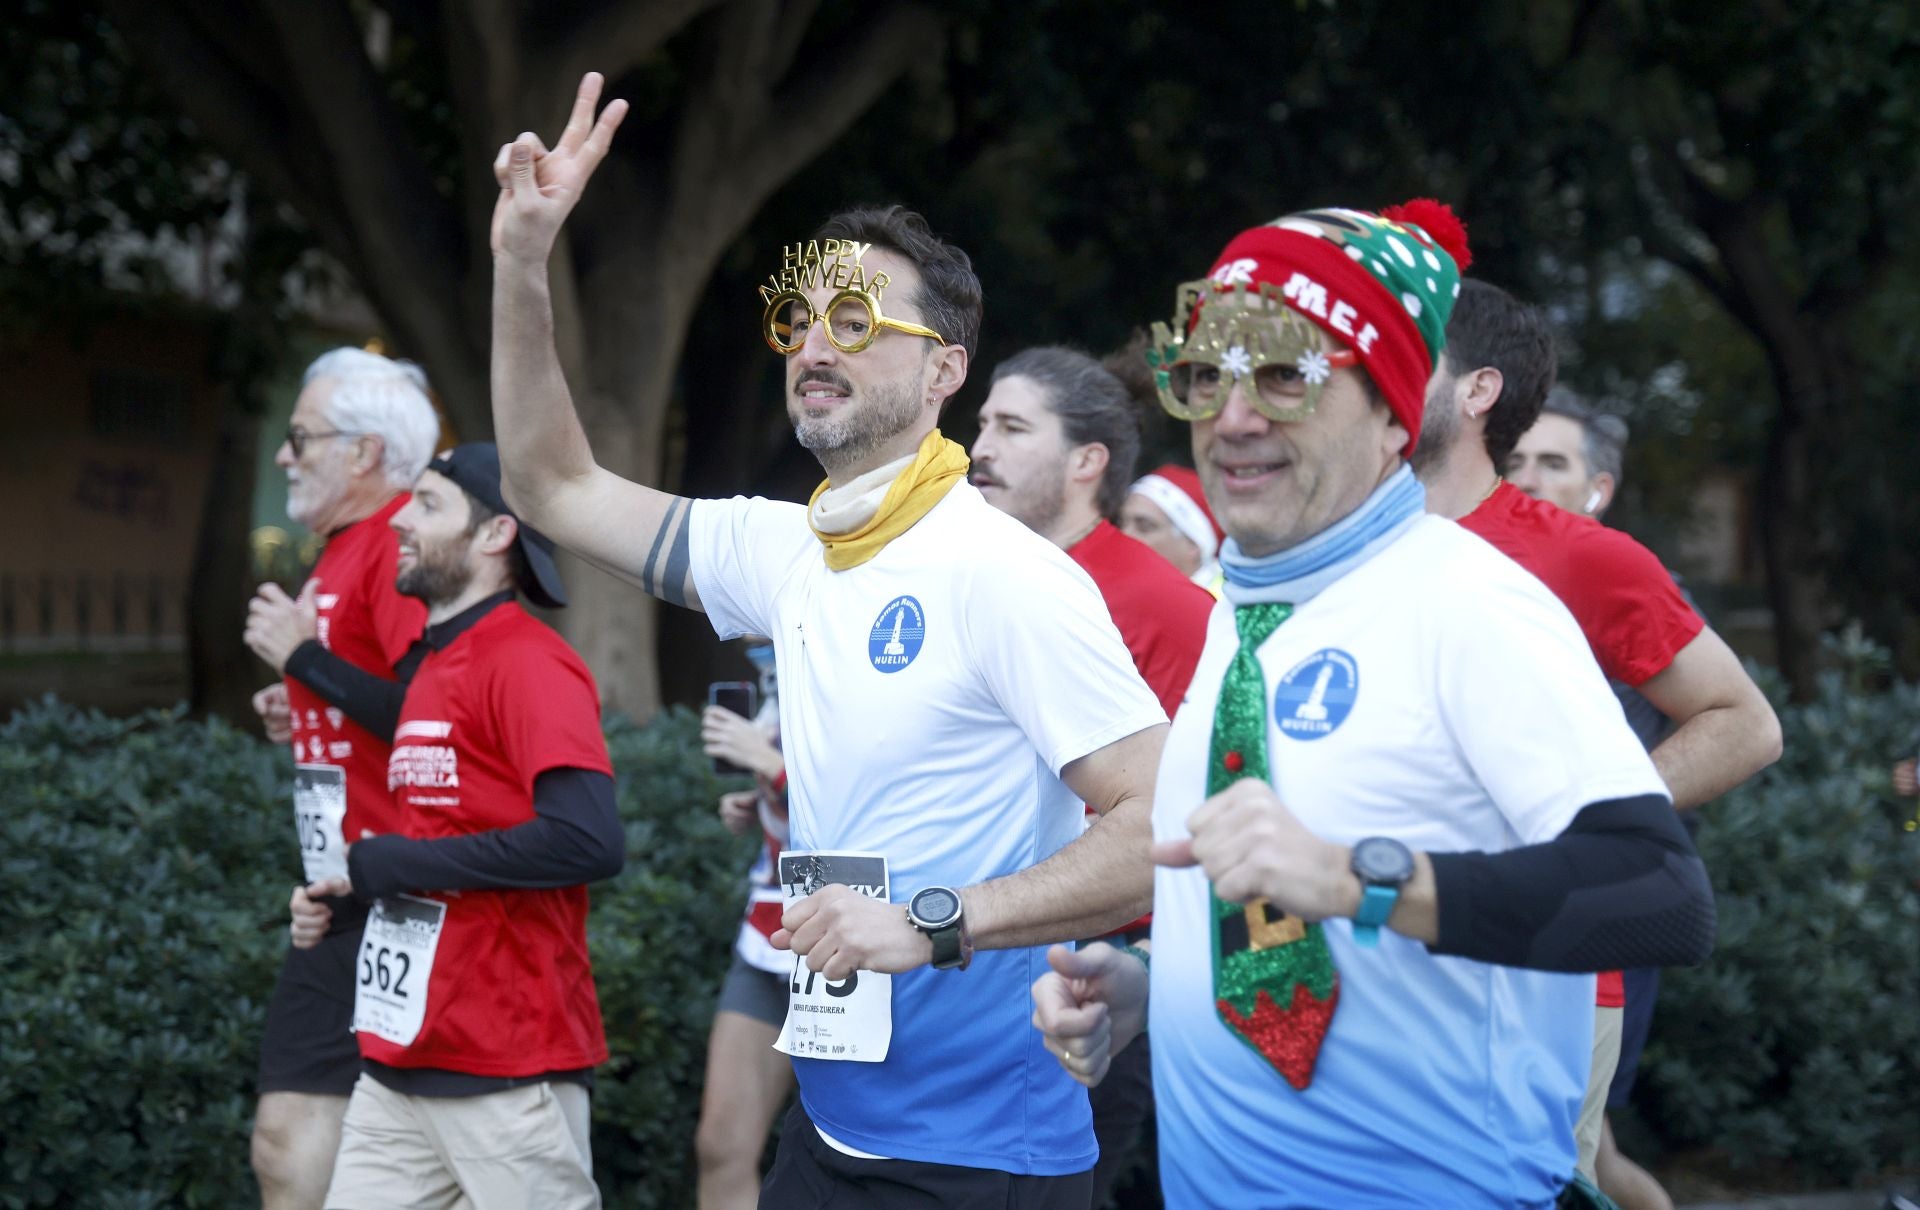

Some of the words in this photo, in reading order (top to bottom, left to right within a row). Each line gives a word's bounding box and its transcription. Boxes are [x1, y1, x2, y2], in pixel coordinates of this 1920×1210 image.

[783, 238, 872, 270] HAPPY
[759, 263, 821, 305] NEW
[819, 262, 891, 301] YEAR
[1283, 272, 1380, 354] ME!
[900, 598, 922, 627] Runners
[874, 655, 909, 665] HUELIN
[1281, 717, 1333, 732] HUELIN
[360, 941, 409, 998] 562
[805, 1004, 819, 1013] FLORES
[819, 1005, 846, 1014] ZURERA
